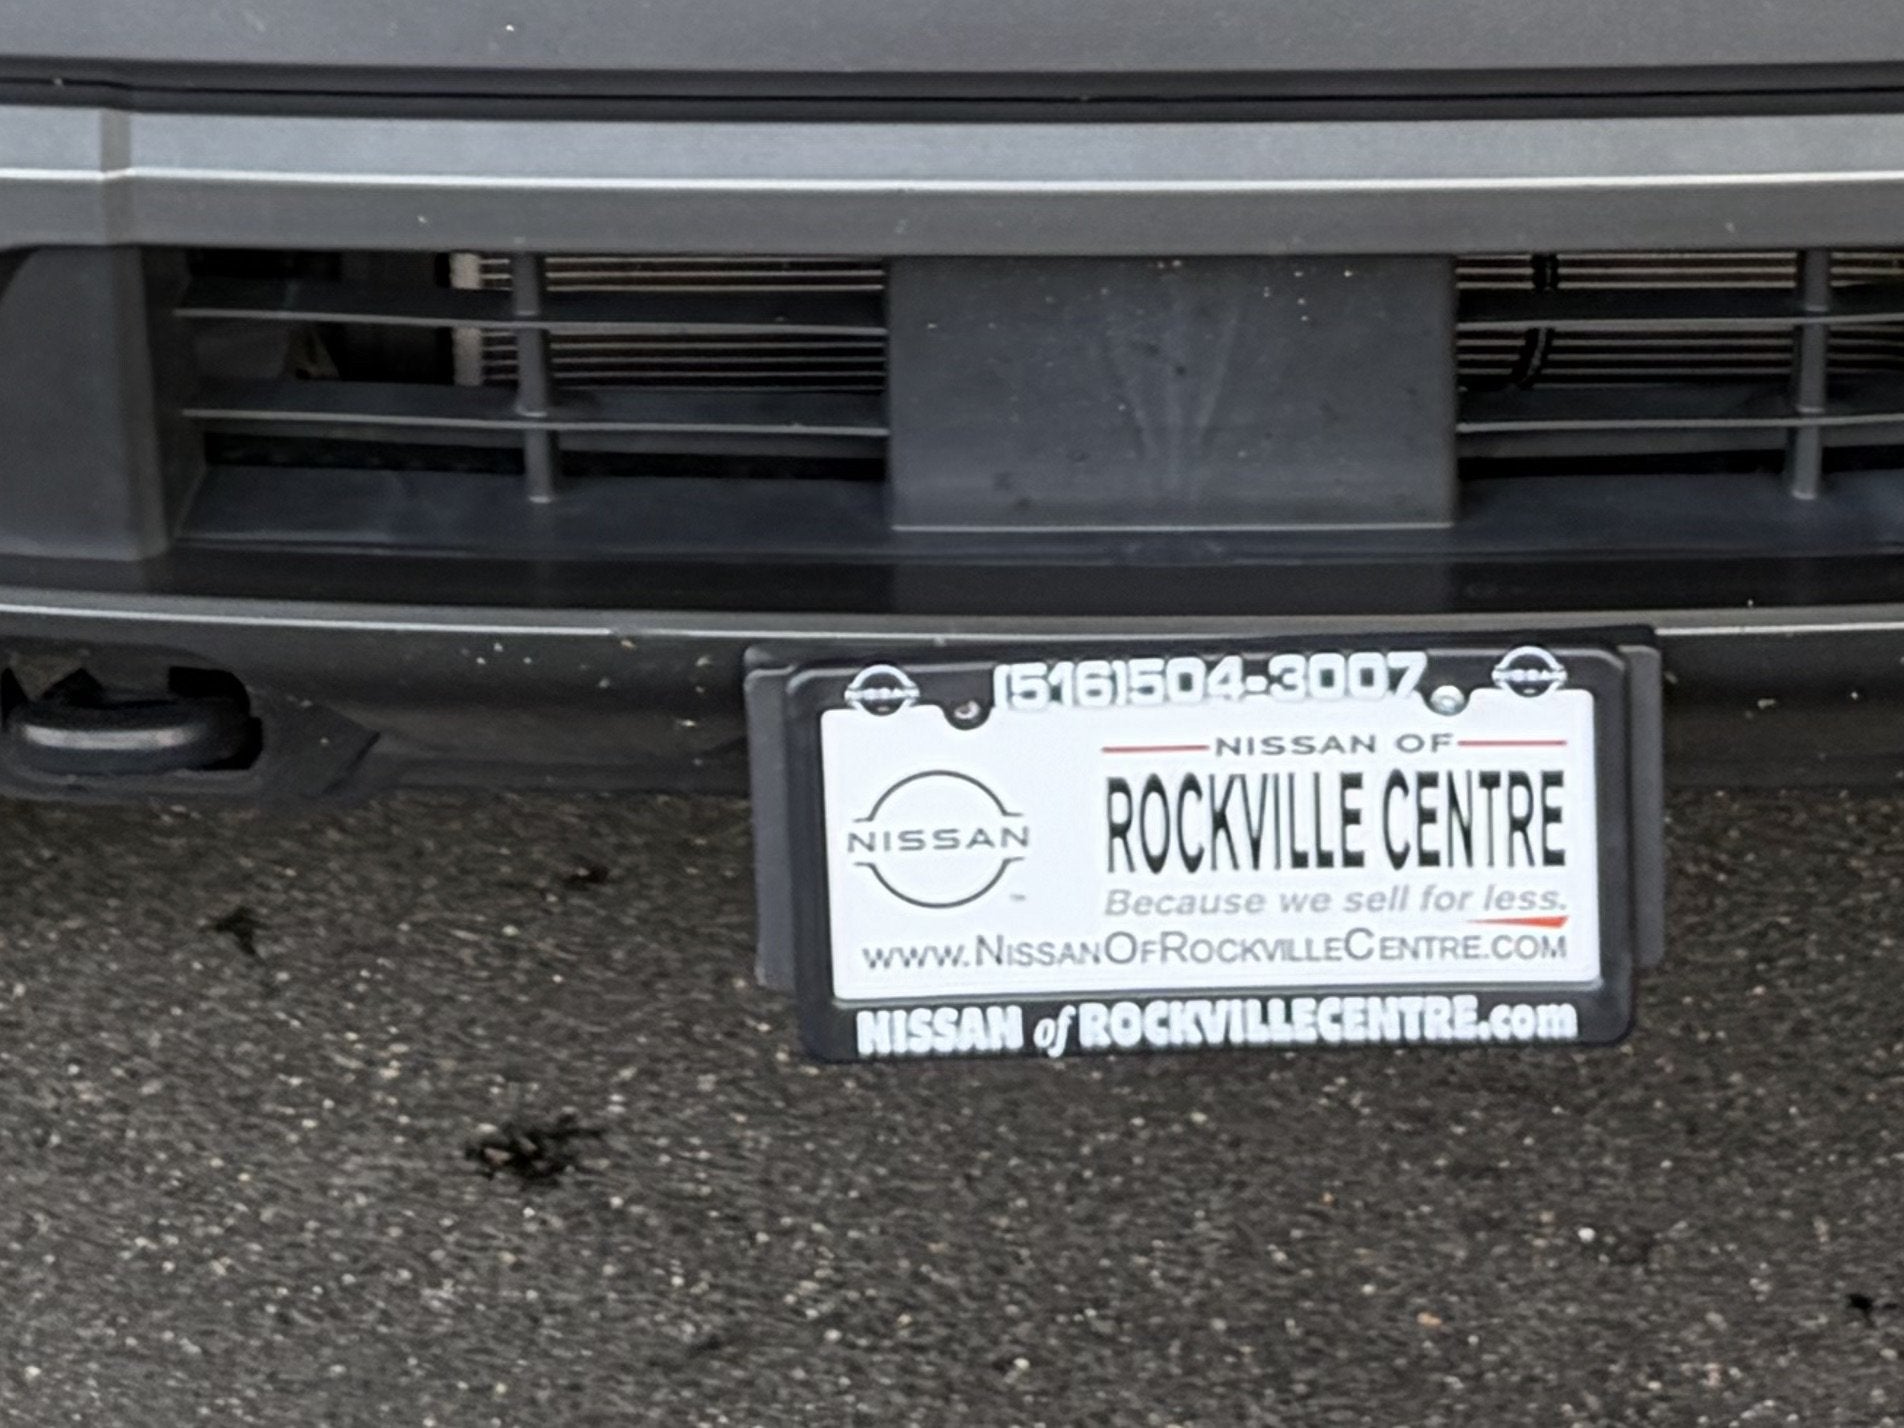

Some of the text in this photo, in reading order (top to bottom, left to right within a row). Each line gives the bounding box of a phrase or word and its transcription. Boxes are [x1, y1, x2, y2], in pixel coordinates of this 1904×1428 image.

[1215, 732, 1454, 757] NISSAN OF
[1106, 768, 1567, 876] ROCKVILLE CENTRE
[847, 826, 1030, 854] NISSAN
[1104, 883, 1569, 917] Because we sell for less.
[856, 1003, 1024, 1057] NISSAN
[1032, 1003, 1077, 1059] of
